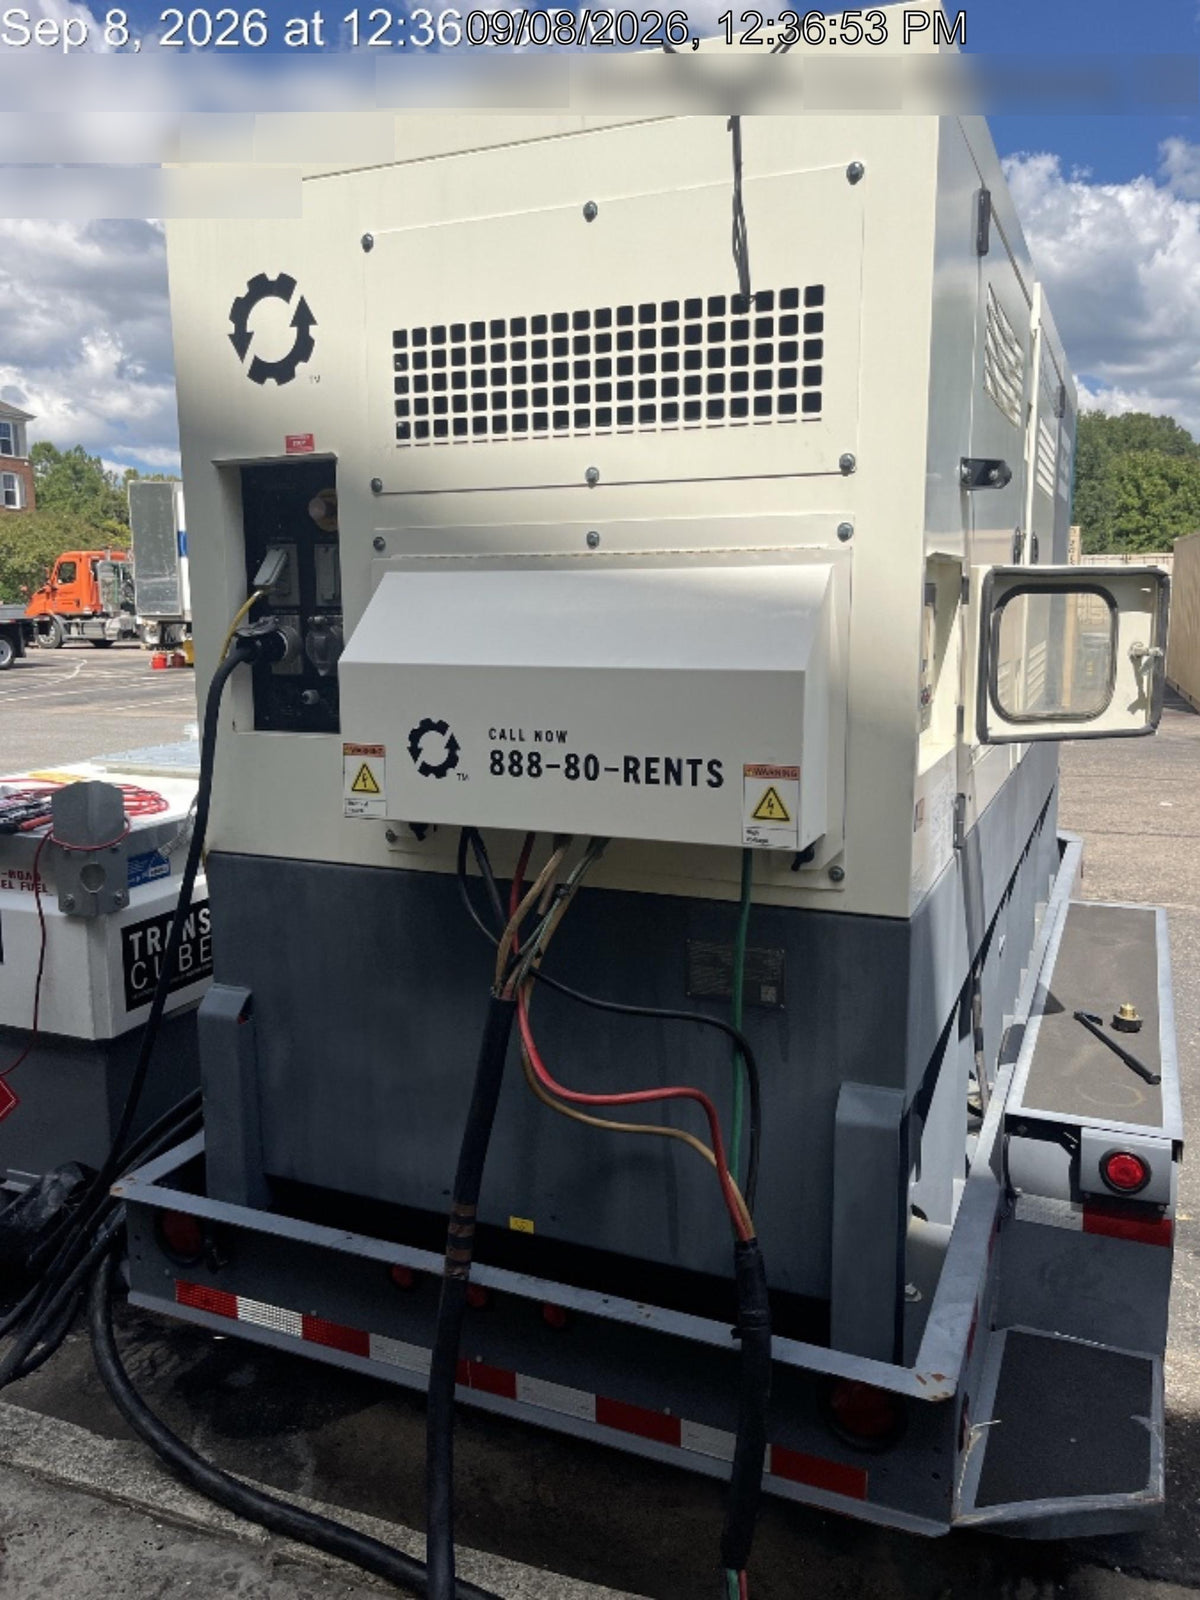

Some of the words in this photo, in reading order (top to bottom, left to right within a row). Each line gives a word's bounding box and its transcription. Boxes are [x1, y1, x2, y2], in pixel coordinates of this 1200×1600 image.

[488, 728, 525, 742] CALL
[534, 730, 568, 744] NOW
[489, 749, 724, 789] 888-80-RENTS
[0, 879, 15, 890] EL
